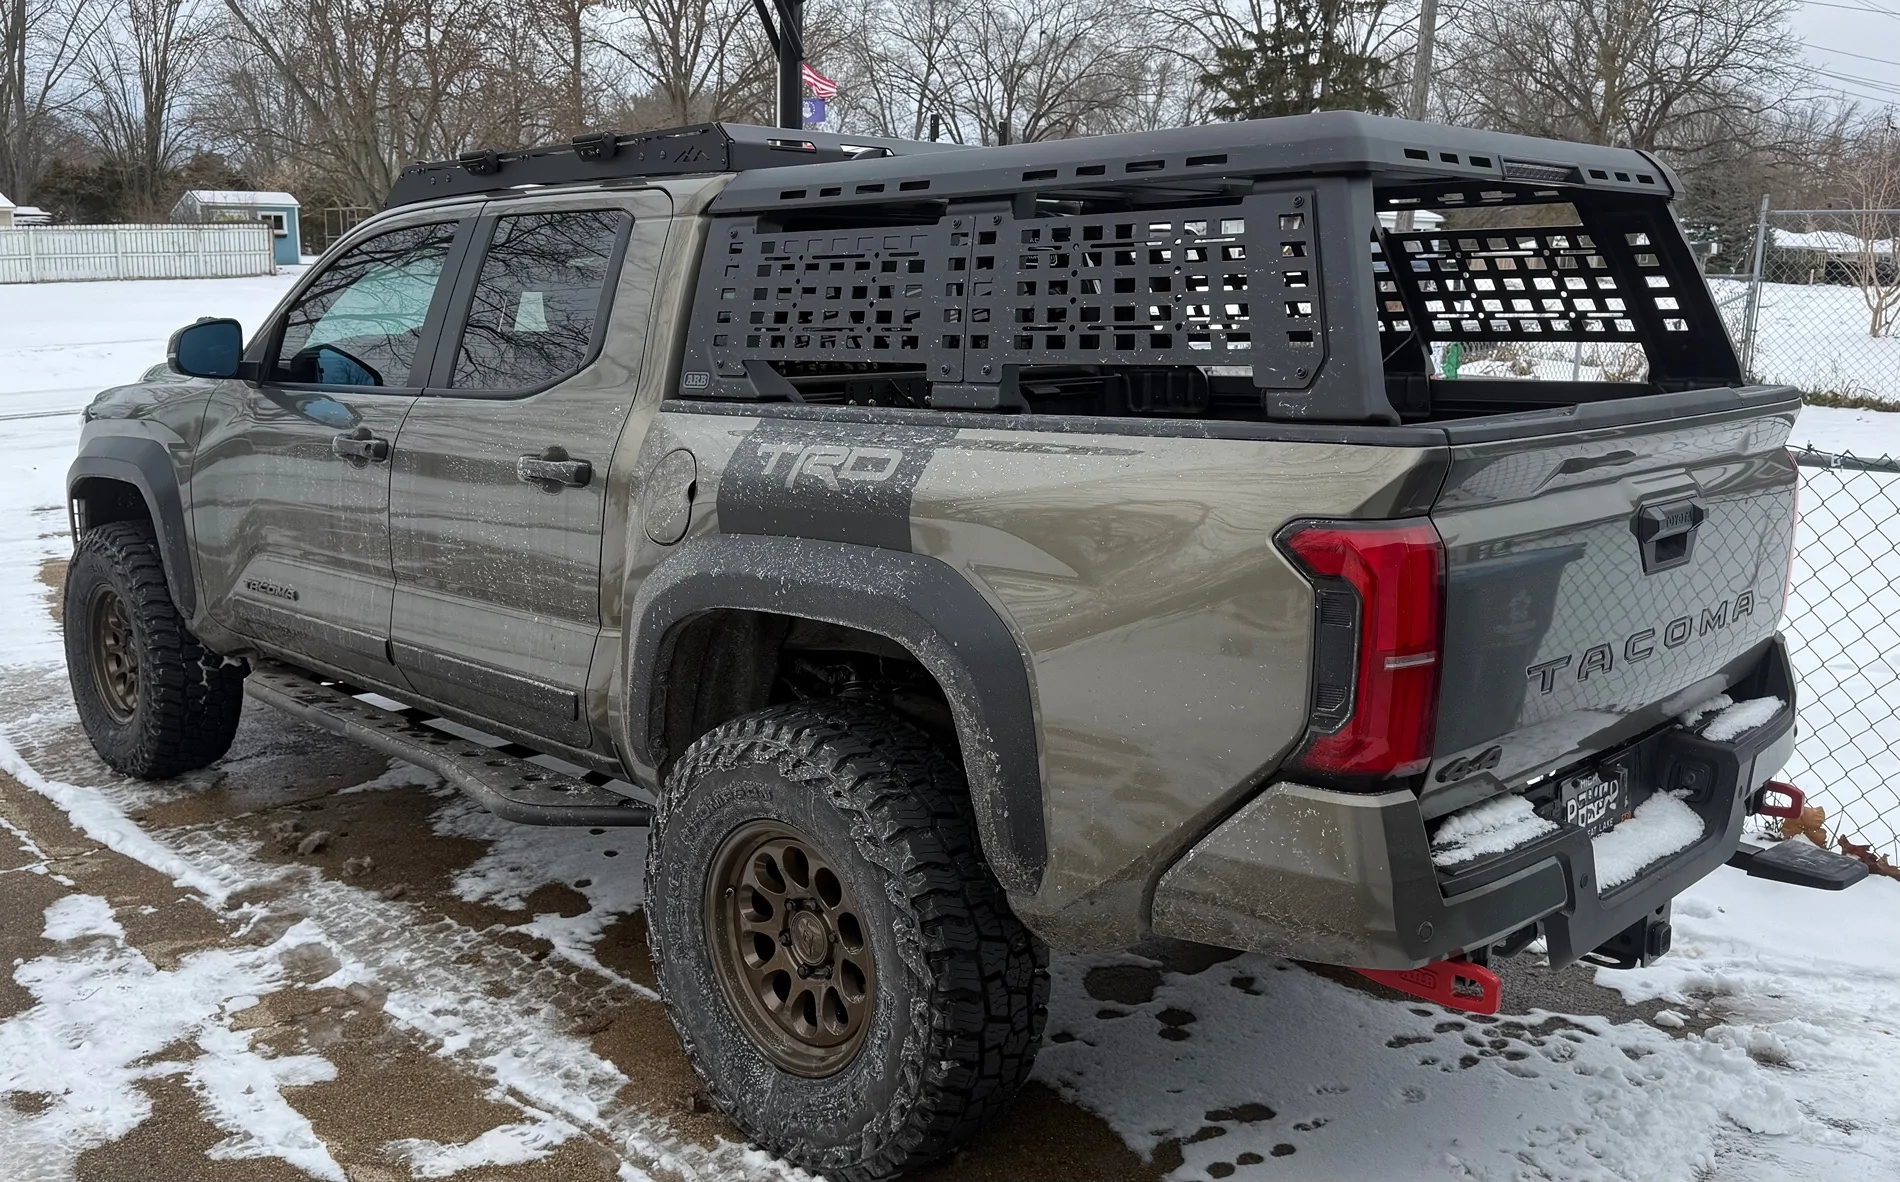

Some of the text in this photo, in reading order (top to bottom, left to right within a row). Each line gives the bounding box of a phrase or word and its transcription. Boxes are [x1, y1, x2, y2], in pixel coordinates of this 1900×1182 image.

[685, 374, 708, 386] ARB
[757, 443, 903, 491] TRD
[1666, 510, 1694, 529] TOYOTA
[243, 578, 299, 601] TACOMA
[1526, 590, 1754, 696] TACOMA
